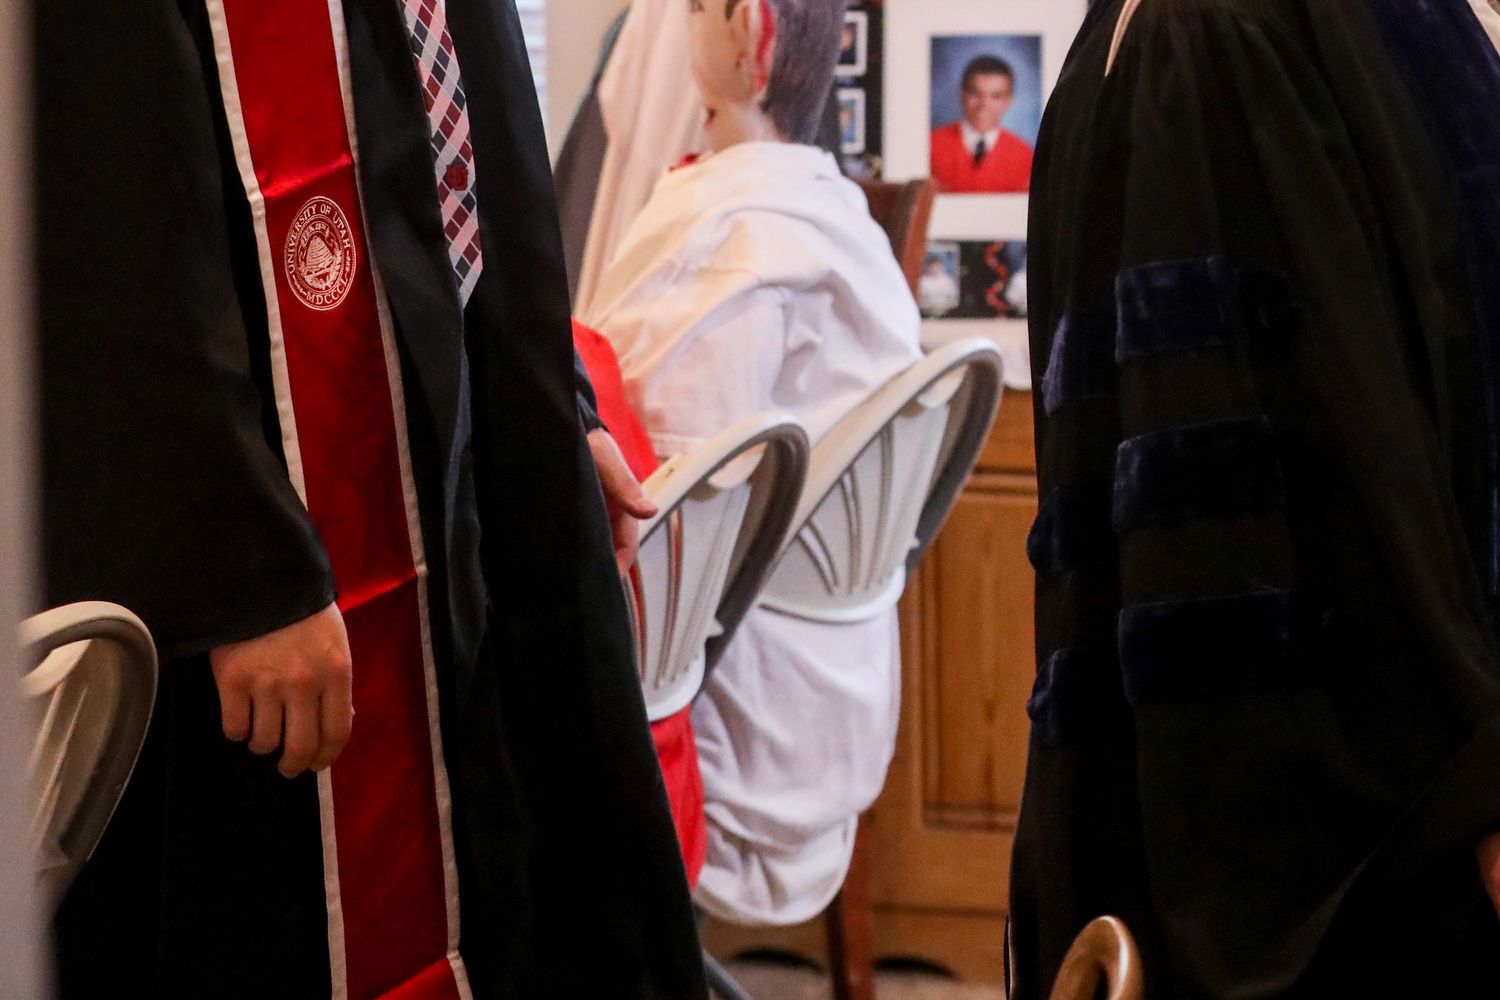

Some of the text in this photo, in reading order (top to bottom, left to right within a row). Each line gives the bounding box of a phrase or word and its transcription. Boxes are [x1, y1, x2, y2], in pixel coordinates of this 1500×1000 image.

[287, 203, 317, 275] UNIVERSITY
[320, 203, 332, 215] OF
[333, 212, 351, 248] UTAH
